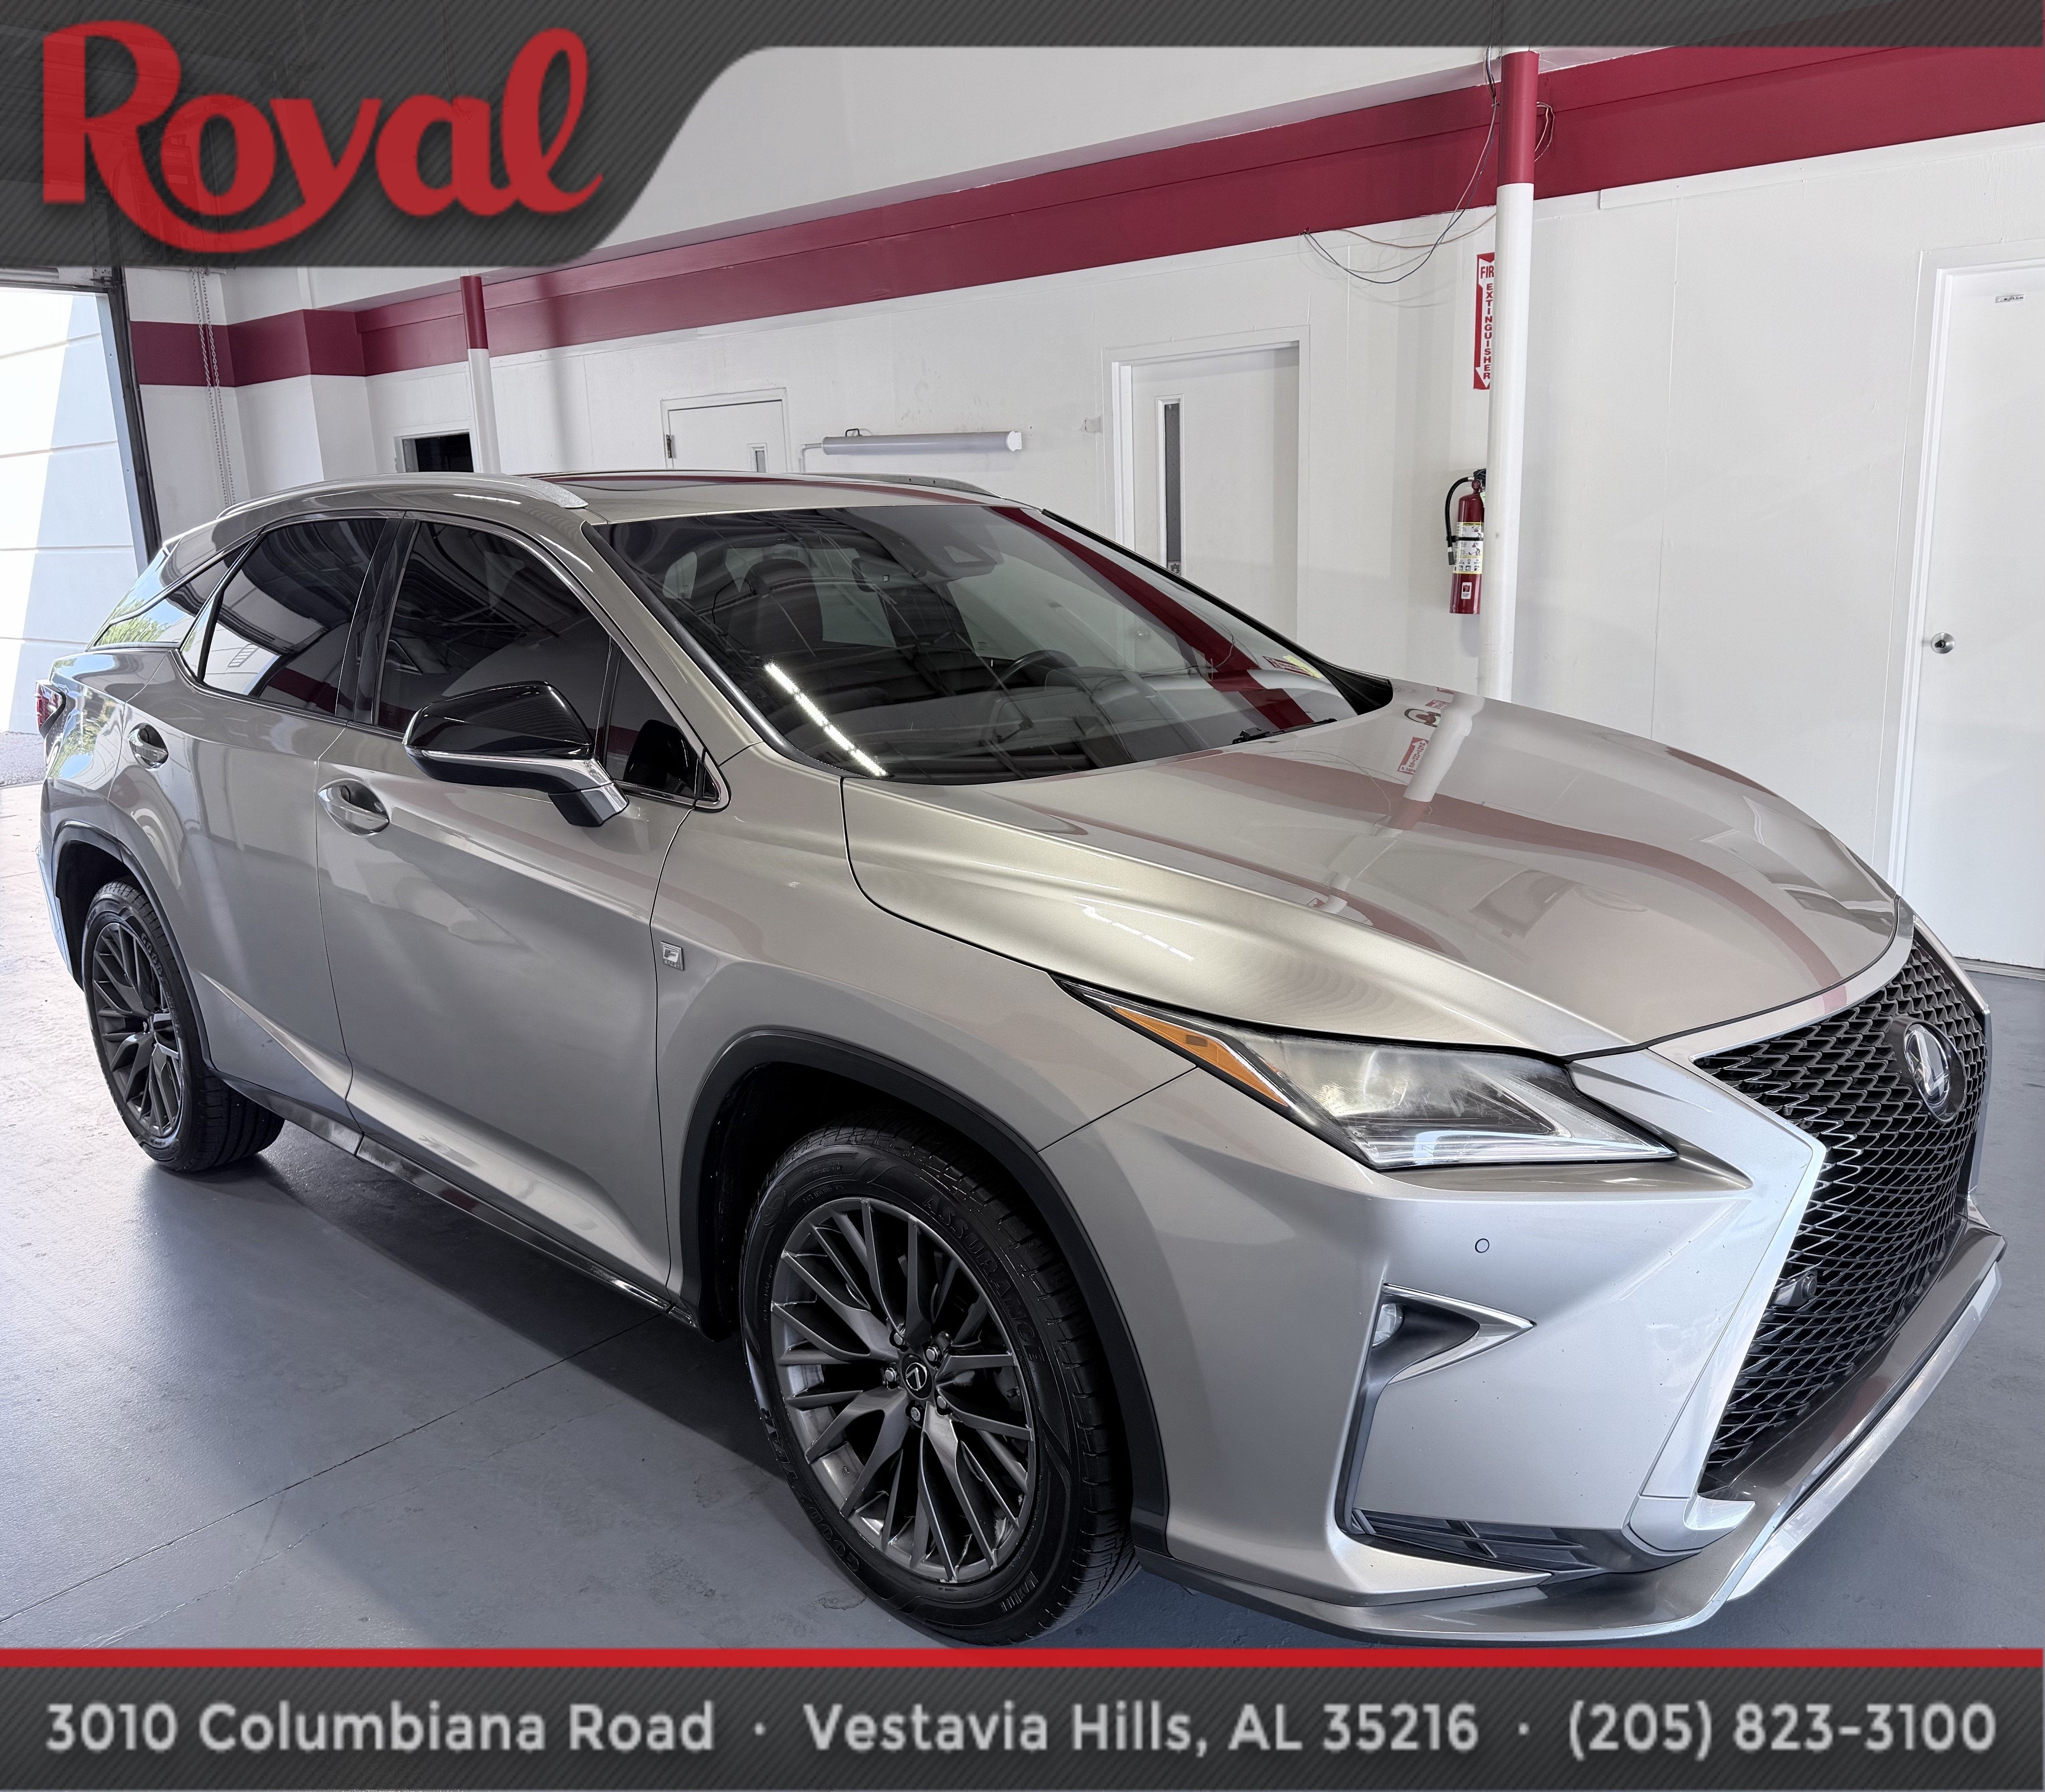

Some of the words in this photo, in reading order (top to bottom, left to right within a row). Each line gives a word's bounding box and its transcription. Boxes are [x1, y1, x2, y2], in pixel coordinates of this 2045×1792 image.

[1480, 265, 1494, 279] FIR
[1483, 283, 1494, 379] EXTINGUISHER
[922, 1194, 1045, 1362] ASSURANCE
